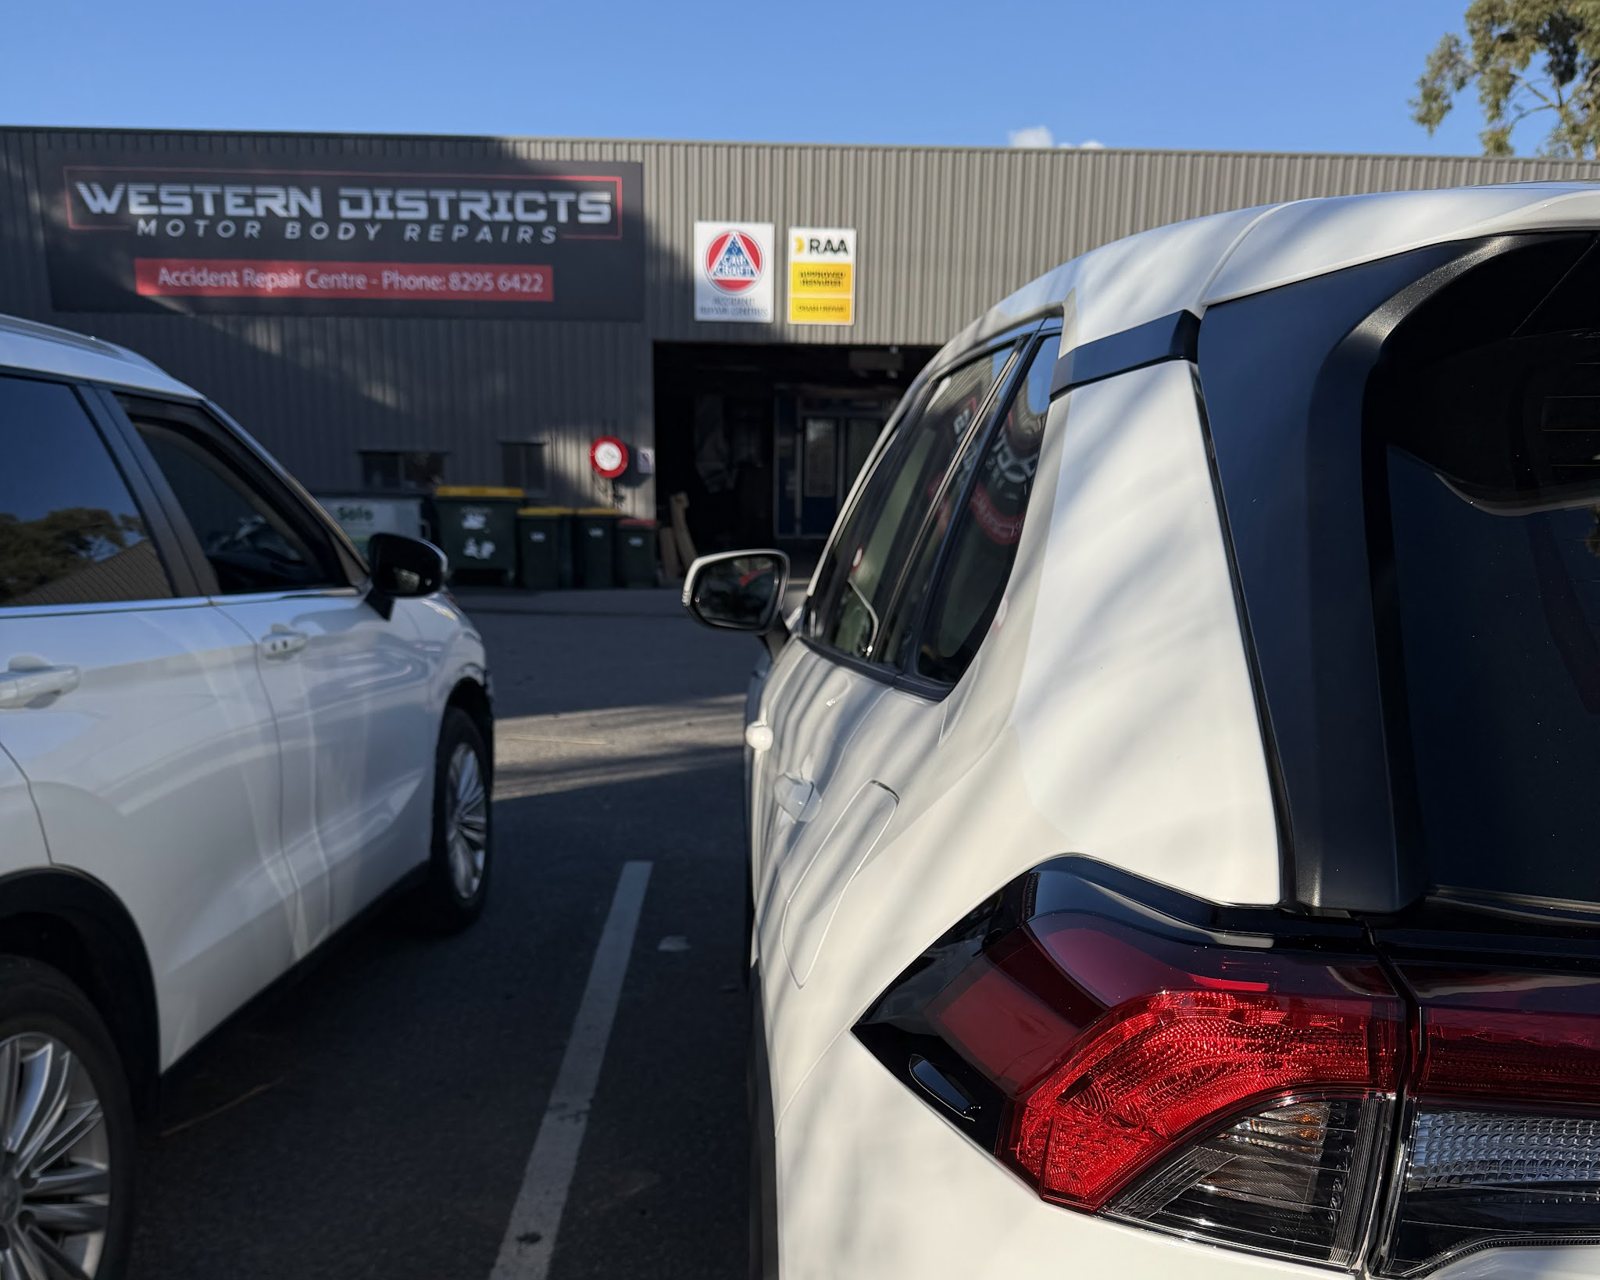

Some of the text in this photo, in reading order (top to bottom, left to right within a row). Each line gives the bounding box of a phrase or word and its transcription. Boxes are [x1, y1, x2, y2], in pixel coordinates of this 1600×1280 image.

[75, 181, 612, 224] WESTERN DISTRICTS
[137, 219, 558, 244] MOTOR BODY REPAIRS
[809, 238, 849, 255] RAA
[158, 267, 239, 288] Accident
[243, 268, 301, 292] Repair
[305, 269, 366, 289] Centre
[382, 270, 445, 291] Phone:
[448, 271, 494, 291] 8295
[498, 272, 544, 292] 6422
